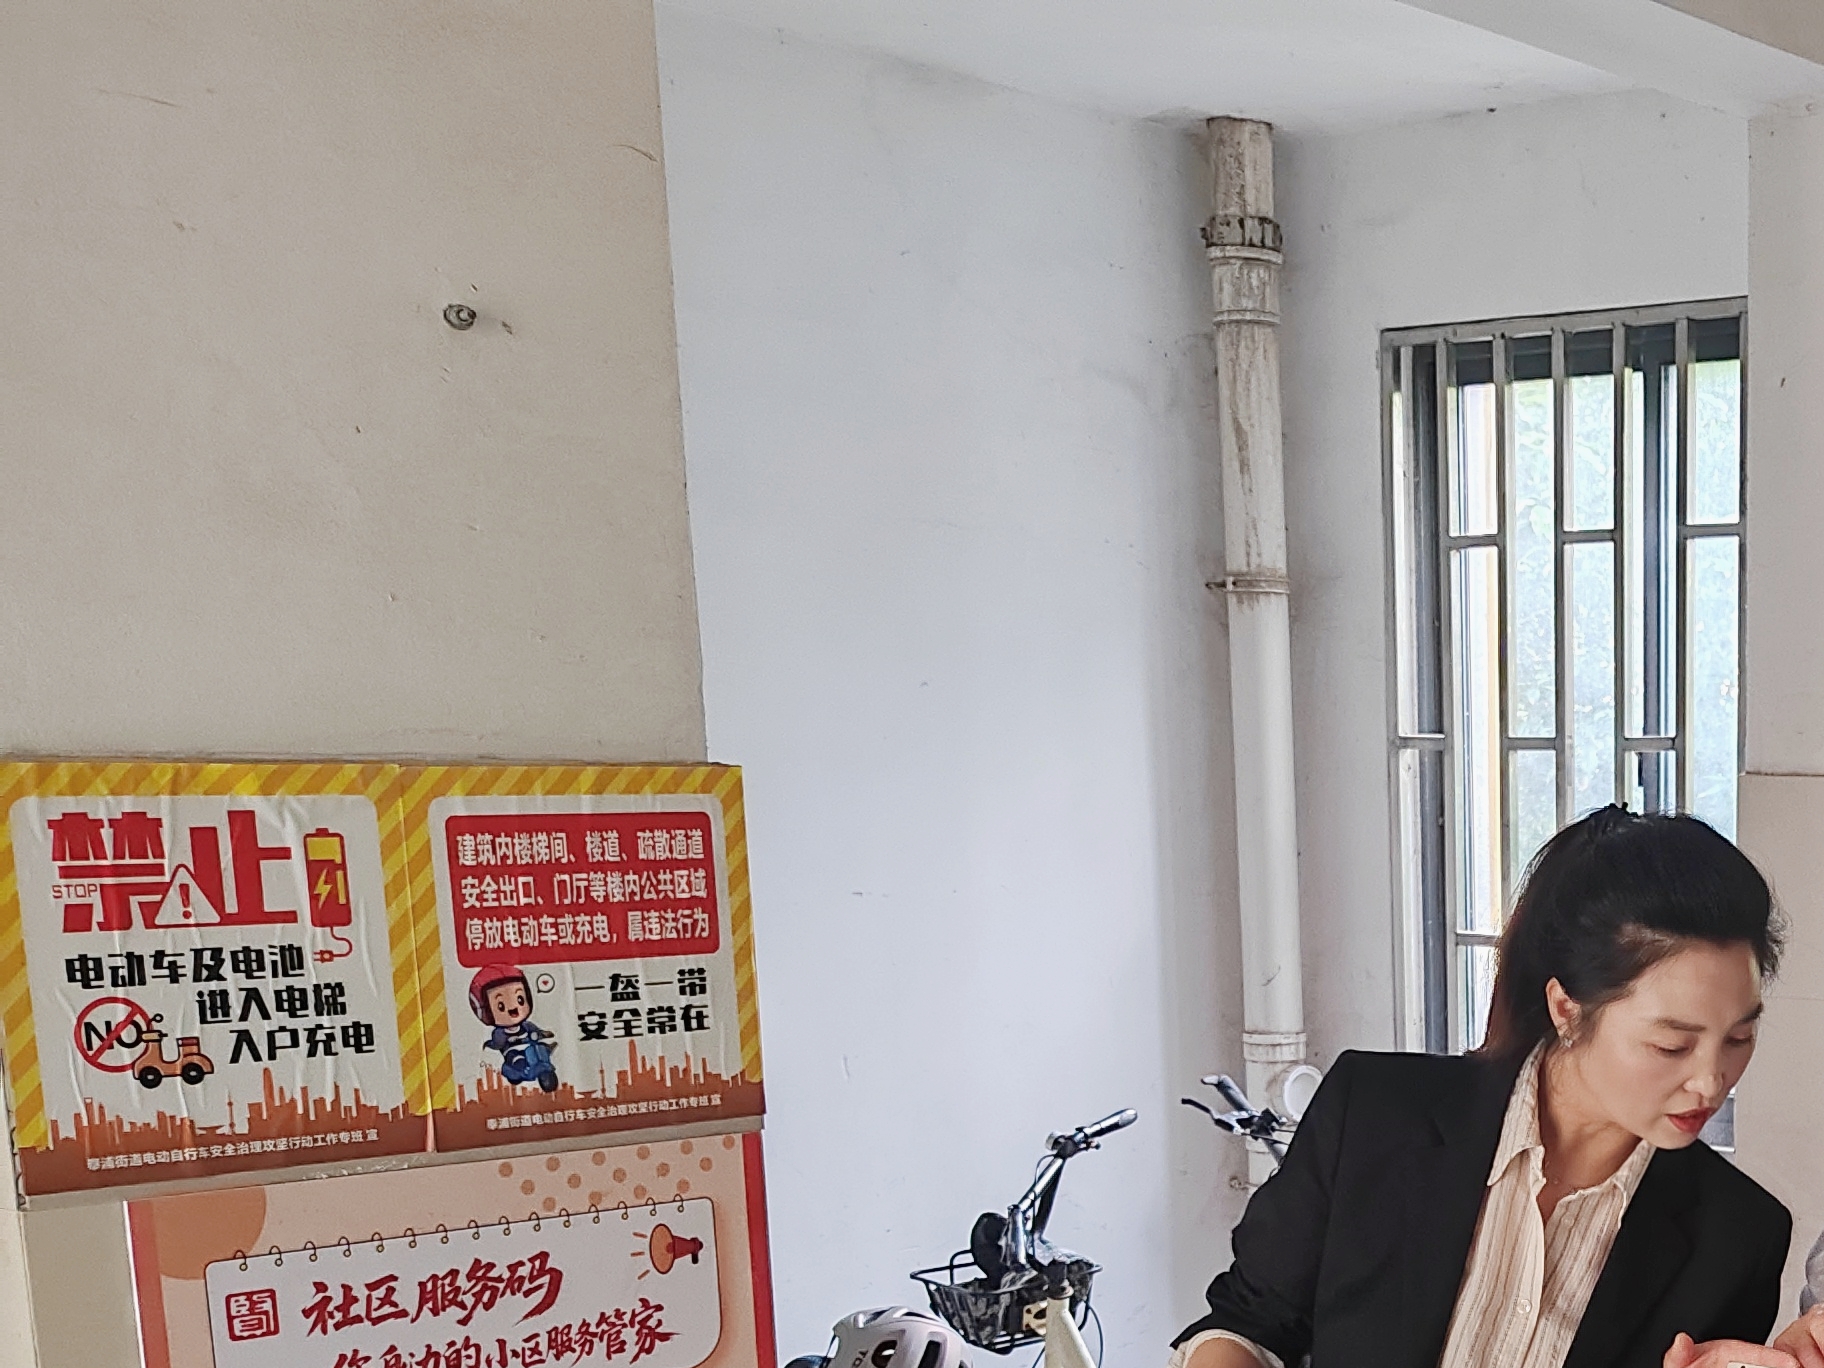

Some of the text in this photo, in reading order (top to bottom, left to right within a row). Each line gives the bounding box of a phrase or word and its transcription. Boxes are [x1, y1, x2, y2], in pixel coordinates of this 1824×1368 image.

[457, 828, 704, 867] 建筑内楼梯间、楼道、疏散通道
[47, 810, 298, 933] 禁止
[52, 884, 98, 900] STOP
[461, 867, 707, 909] 安全出口、门厅等楼内公共区域
[65, 944, 305, 990] 电动车及电池
[574, 967, 707, 1003] 一盔一带
[196, 982, 348, 1025] 进入电梯
[578, 1003, 710, 1041] 安全常在
[84, 1018, 142, 1051] NO
[229, 1022, 376, 1064] 入户充电
[301, 1251, 564, 1338] 社区服务码
